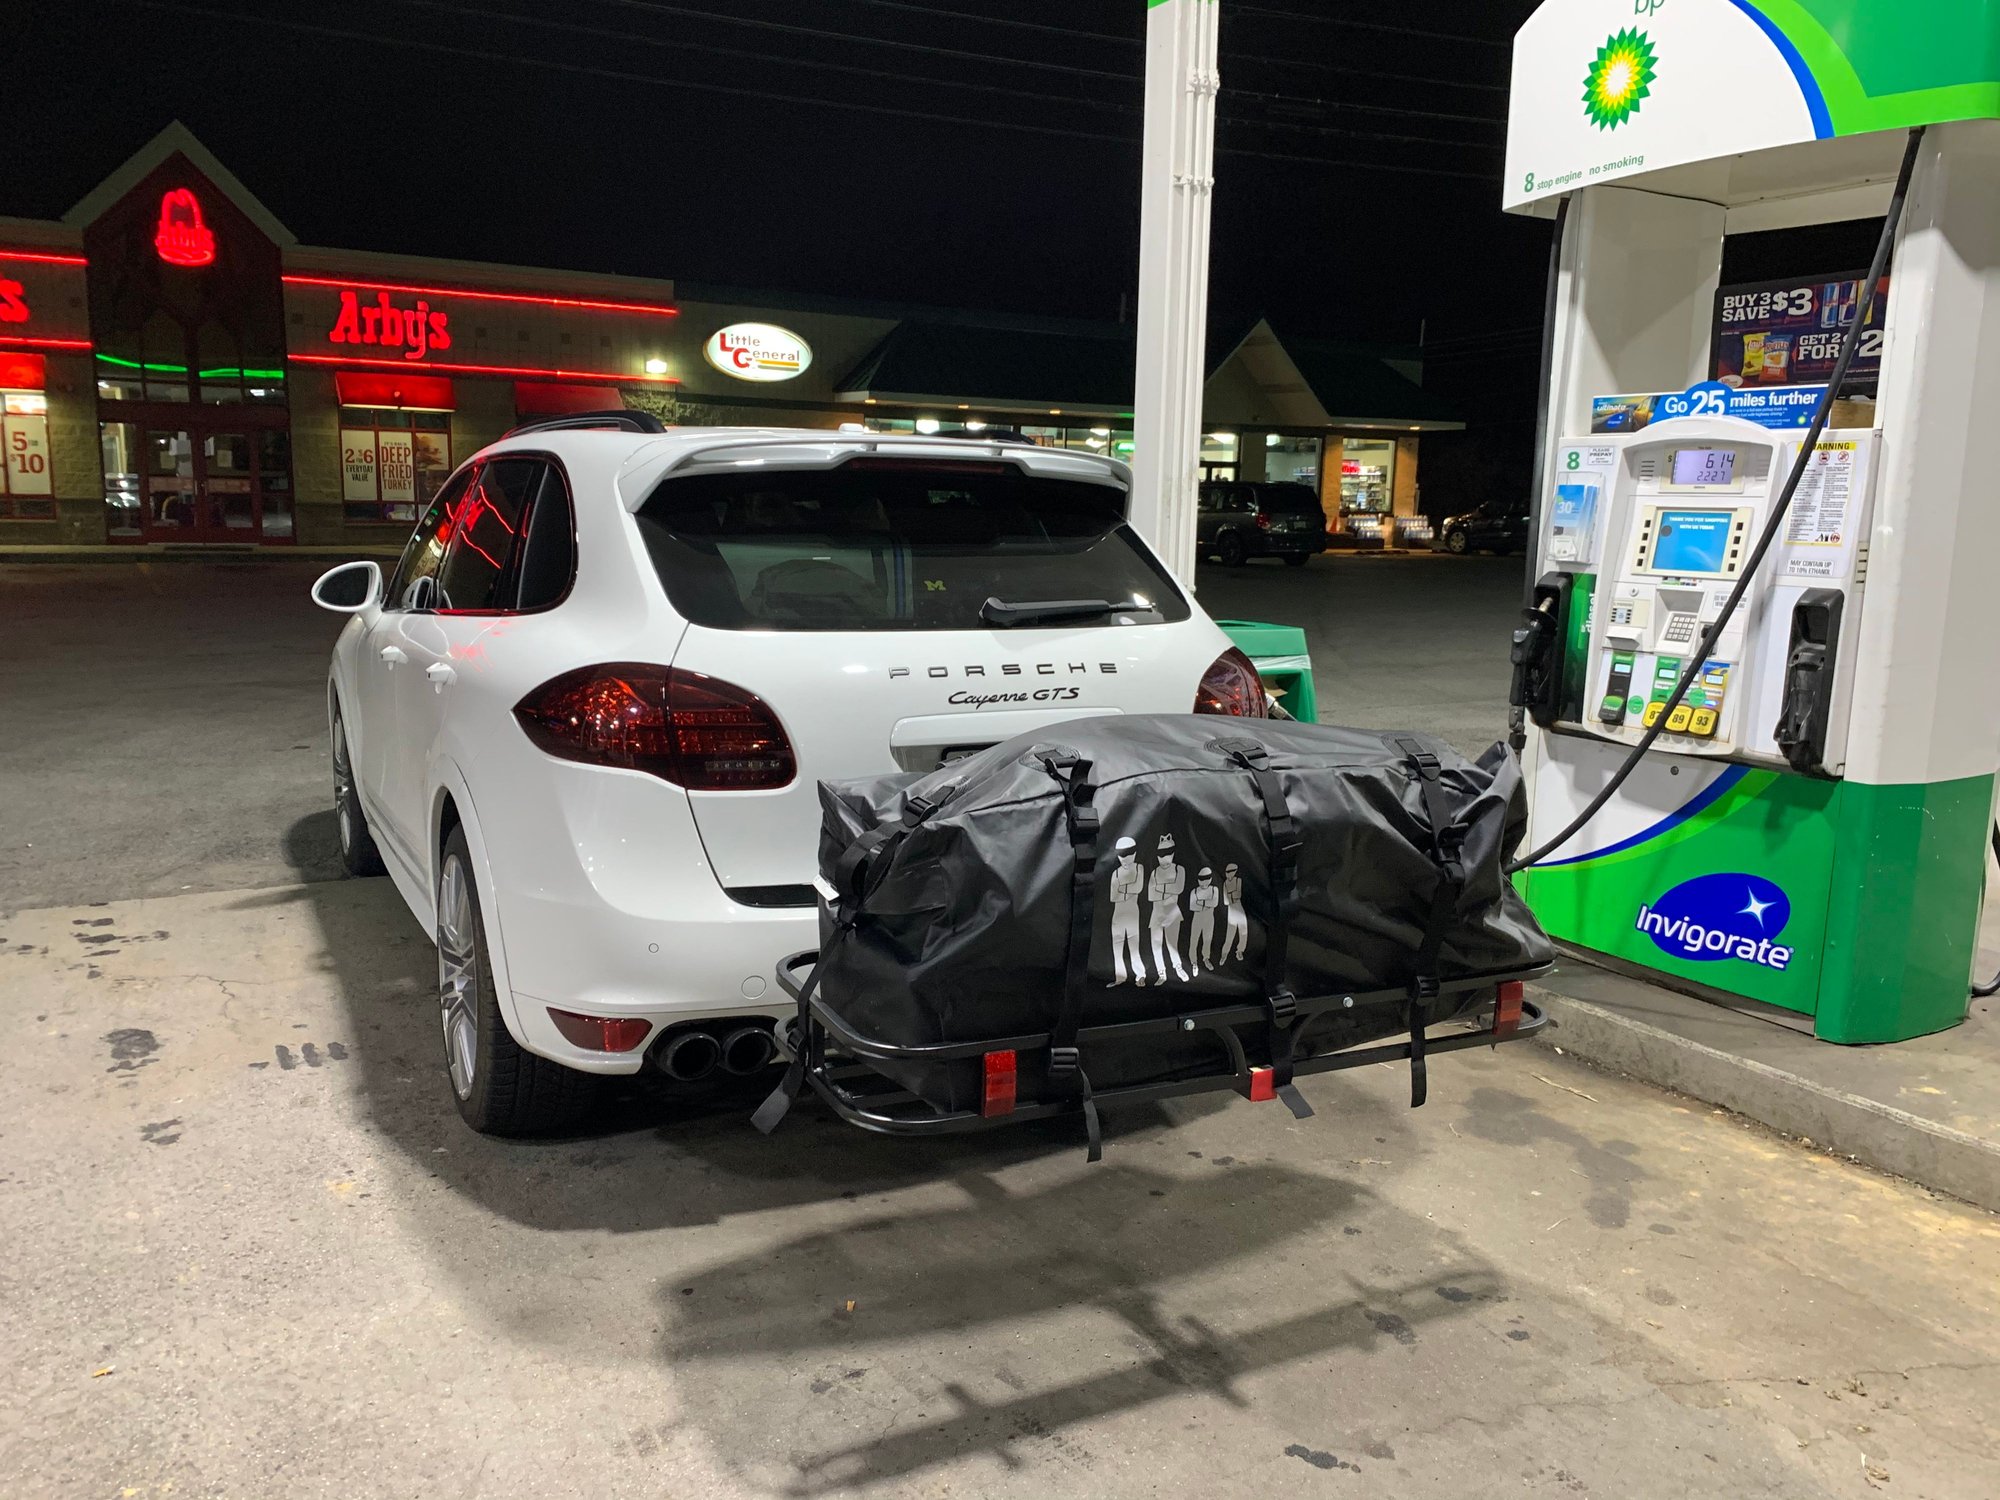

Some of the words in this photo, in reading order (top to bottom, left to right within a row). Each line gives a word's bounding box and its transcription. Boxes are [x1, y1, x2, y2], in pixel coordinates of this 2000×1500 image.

[1589, 166, 1600, 176] no
[1602, 155, 1644, 172] smoking
[1524, 172, 1534, 192] 8
[1536, 180, 1554, 190] stop
[1555, 170, 1582, 184] engine
[1723, 294, 1756, 309] BUY
[1760, 292, 1771, 306] 3
[1772, 288, 1813, 316] $3
[1722, 306, 1770, 322] SAVE
[330, 291, 451, 359] Arby's
[720, 333, 760, 352] Little
[1800, 333, 1829, 346] GET
[1832, 332, 1840, 342] 2
[732, 348, 800, 368] General
[1798, 344, 1839, 360] FOR
[1665, 396, 1688, 414] Go
[1690, 390, 1725, 417] 25
[1730, 393, 1765, 407] miles
[1769, 391, 1818, 406] further
[12, 432, 27, 451] 5
[345, 448, 355, 464] 2
[381, 447, 411, 463] DEEP
[1567, 451, 1580, 469] 8
[382, 464, 412, 479] FRIED
[383, 480, 412, 490] TURKEY
[888, 662, 1117, 679] PORSCHE
[948, 691, 1028, 710] Cayenne
[1033, 687, 1080, 700] GTS
[1672, 714, 1685, 724] 89
[1696, 716, 1709, 726] 93
[1636, 905, 1790, 969] Invigorate
